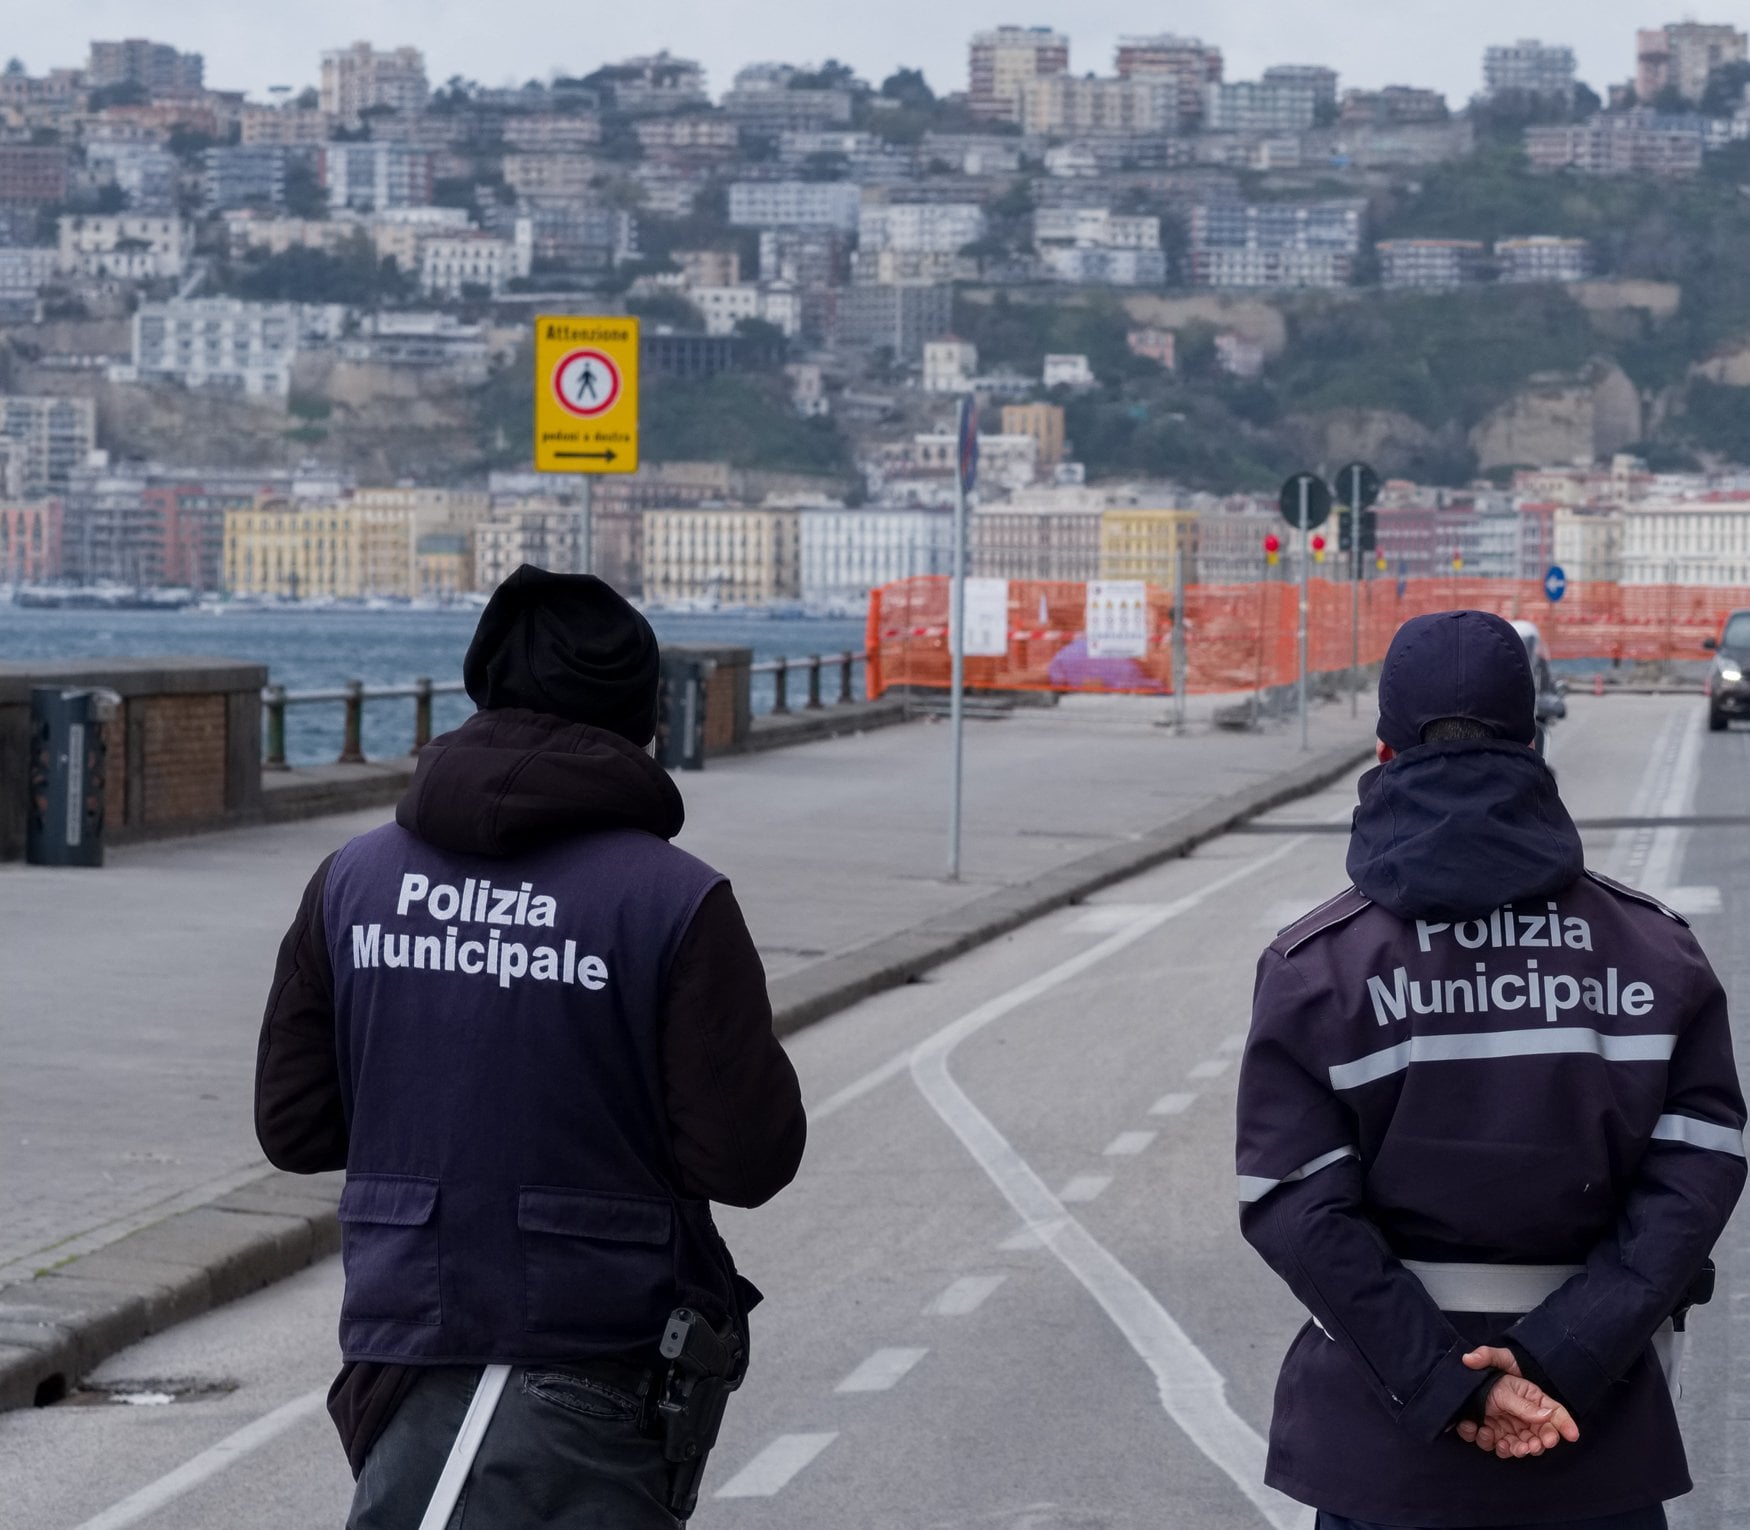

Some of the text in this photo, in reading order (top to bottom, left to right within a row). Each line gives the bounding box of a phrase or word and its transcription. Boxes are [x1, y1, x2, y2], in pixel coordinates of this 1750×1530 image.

[546, 325, 629, 341] Attenzione
[594, 431, 631, 443] destra
[396, 872, 558, 928] Polizia
[1415, 901, 1594, 952] Polizia
[351, 923, 609, 991] Municipale
[1366, 958, 1655, 1027] Municipale
